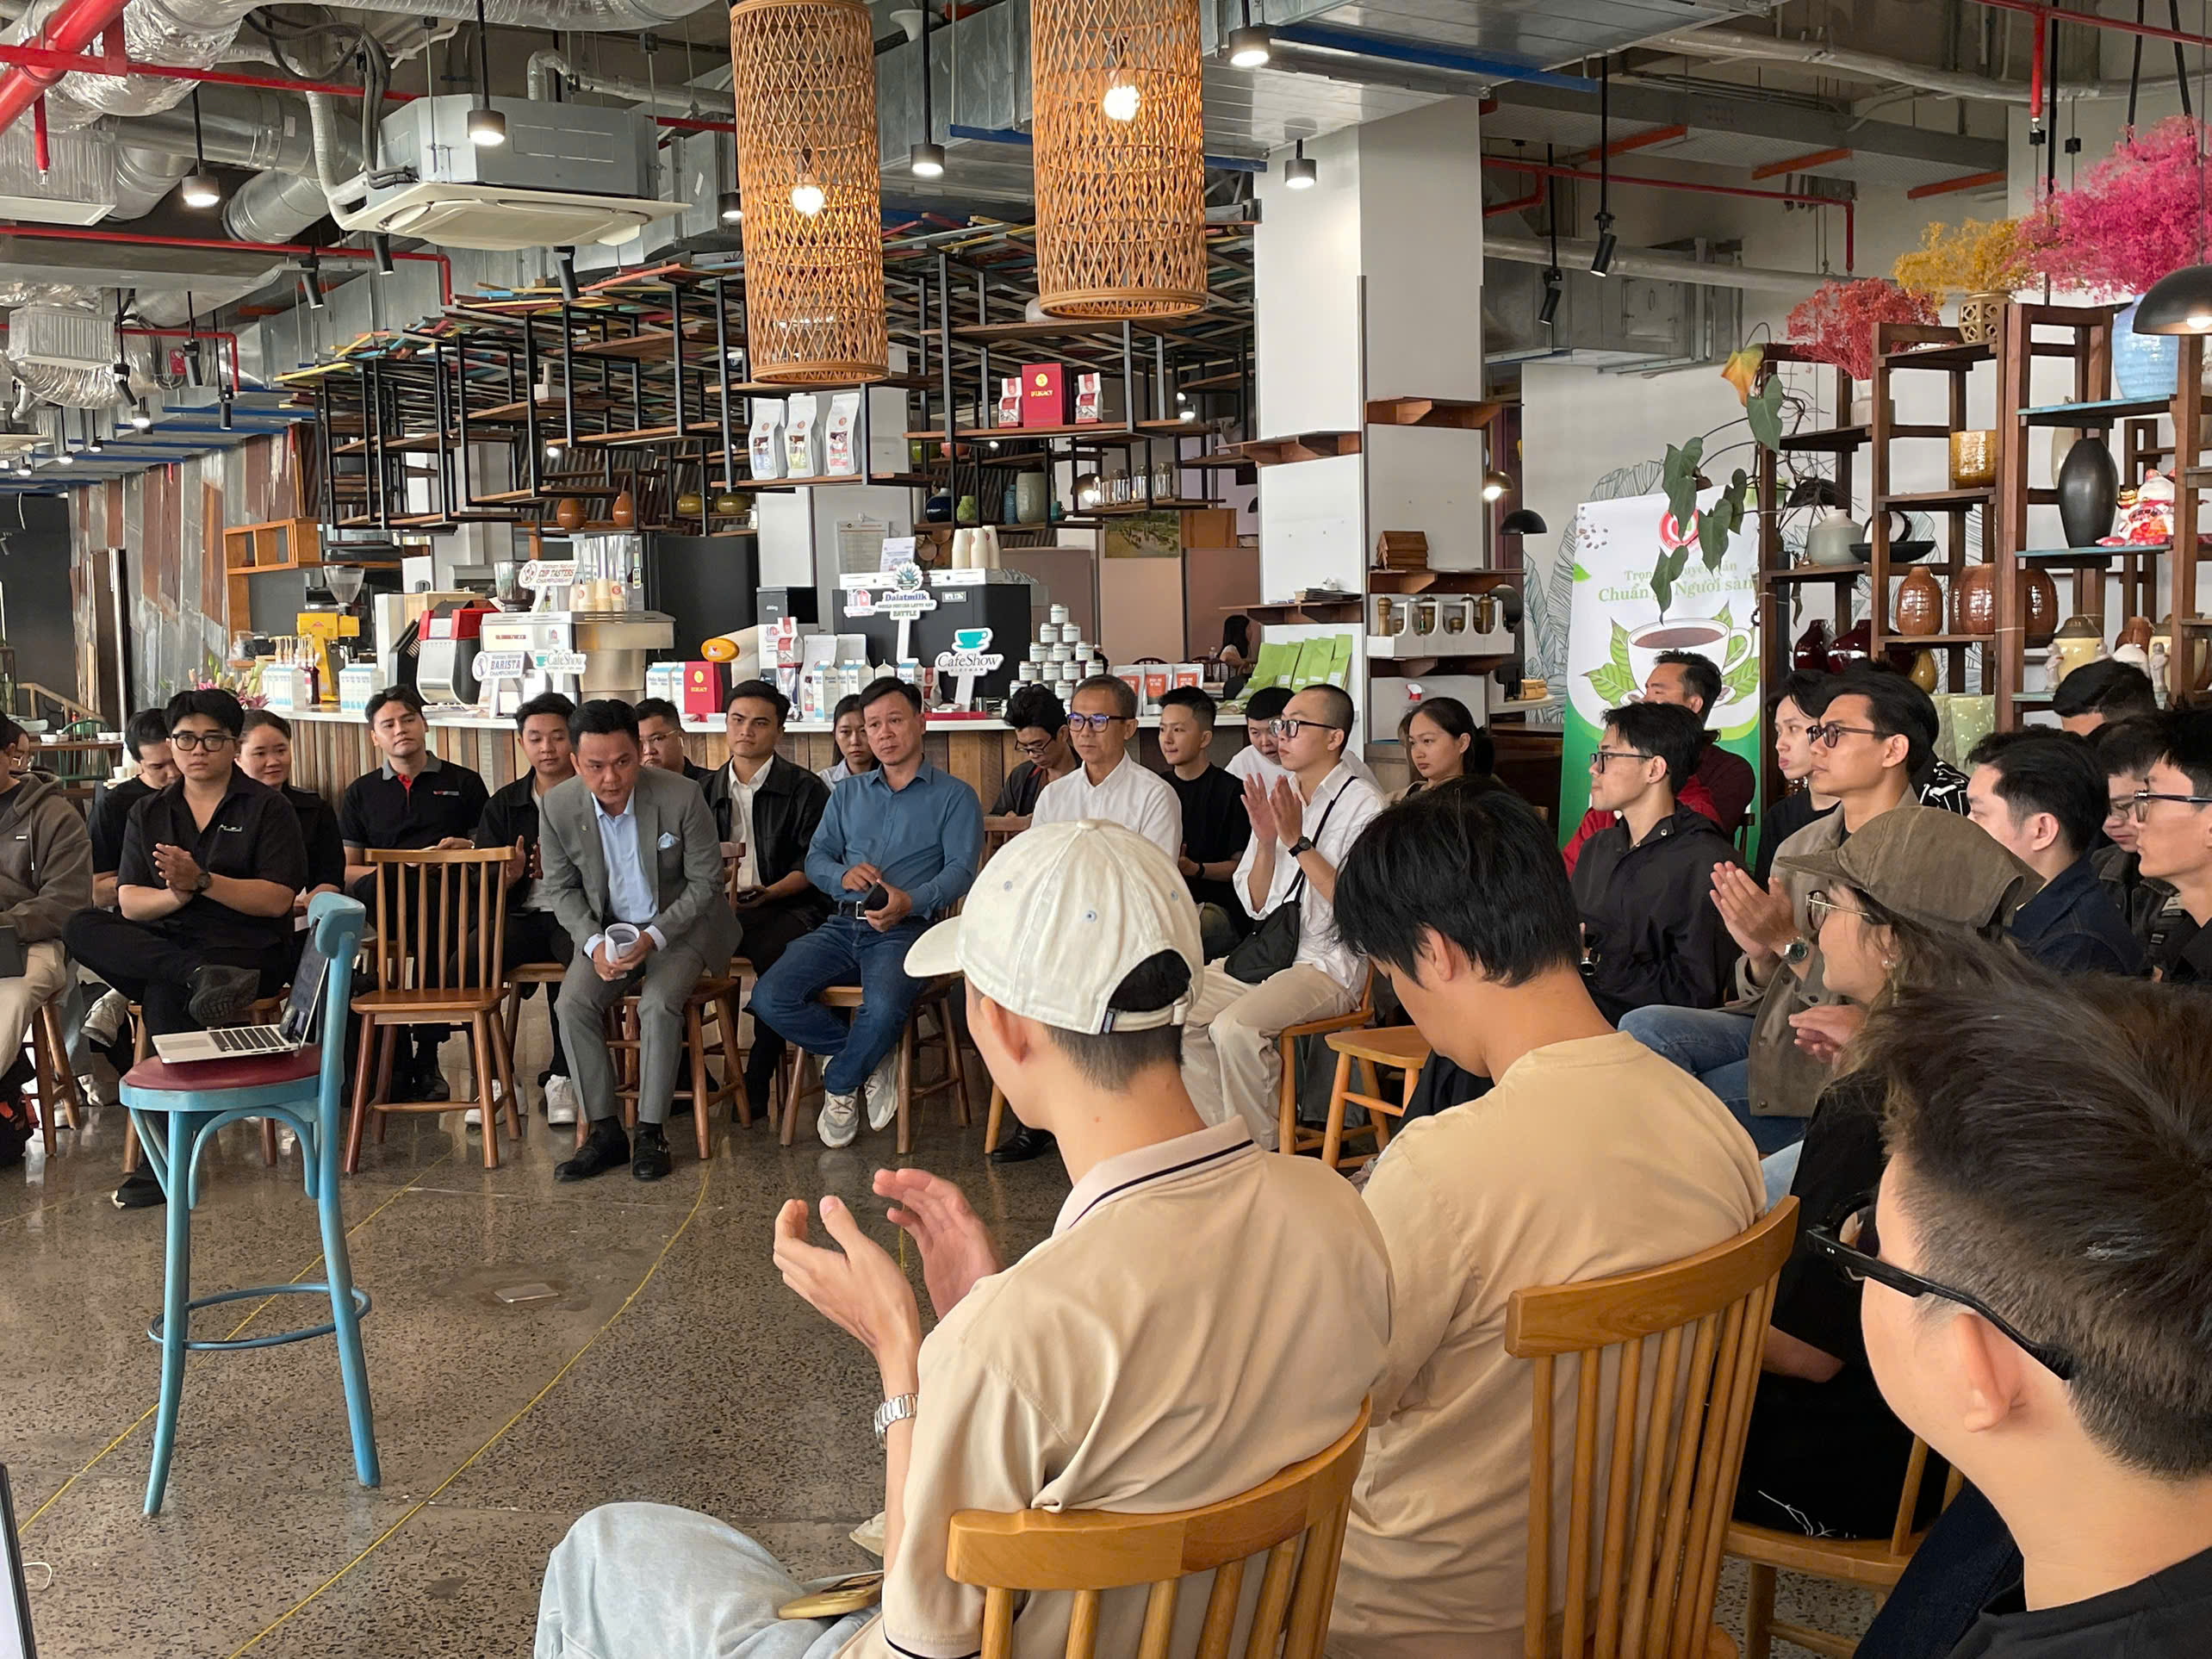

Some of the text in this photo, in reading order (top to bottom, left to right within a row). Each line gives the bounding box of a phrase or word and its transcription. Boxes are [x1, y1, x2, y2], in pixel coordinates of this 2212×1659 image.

[1598, 583, 1649, 602] Chuẩn
[1724, 575, 1754, 591] sàn
[885, 593, 928, 602] Dalatmilk
[490, 660, 520, 670] BARISTA
[937, 653, 999, 668] CafeShow
